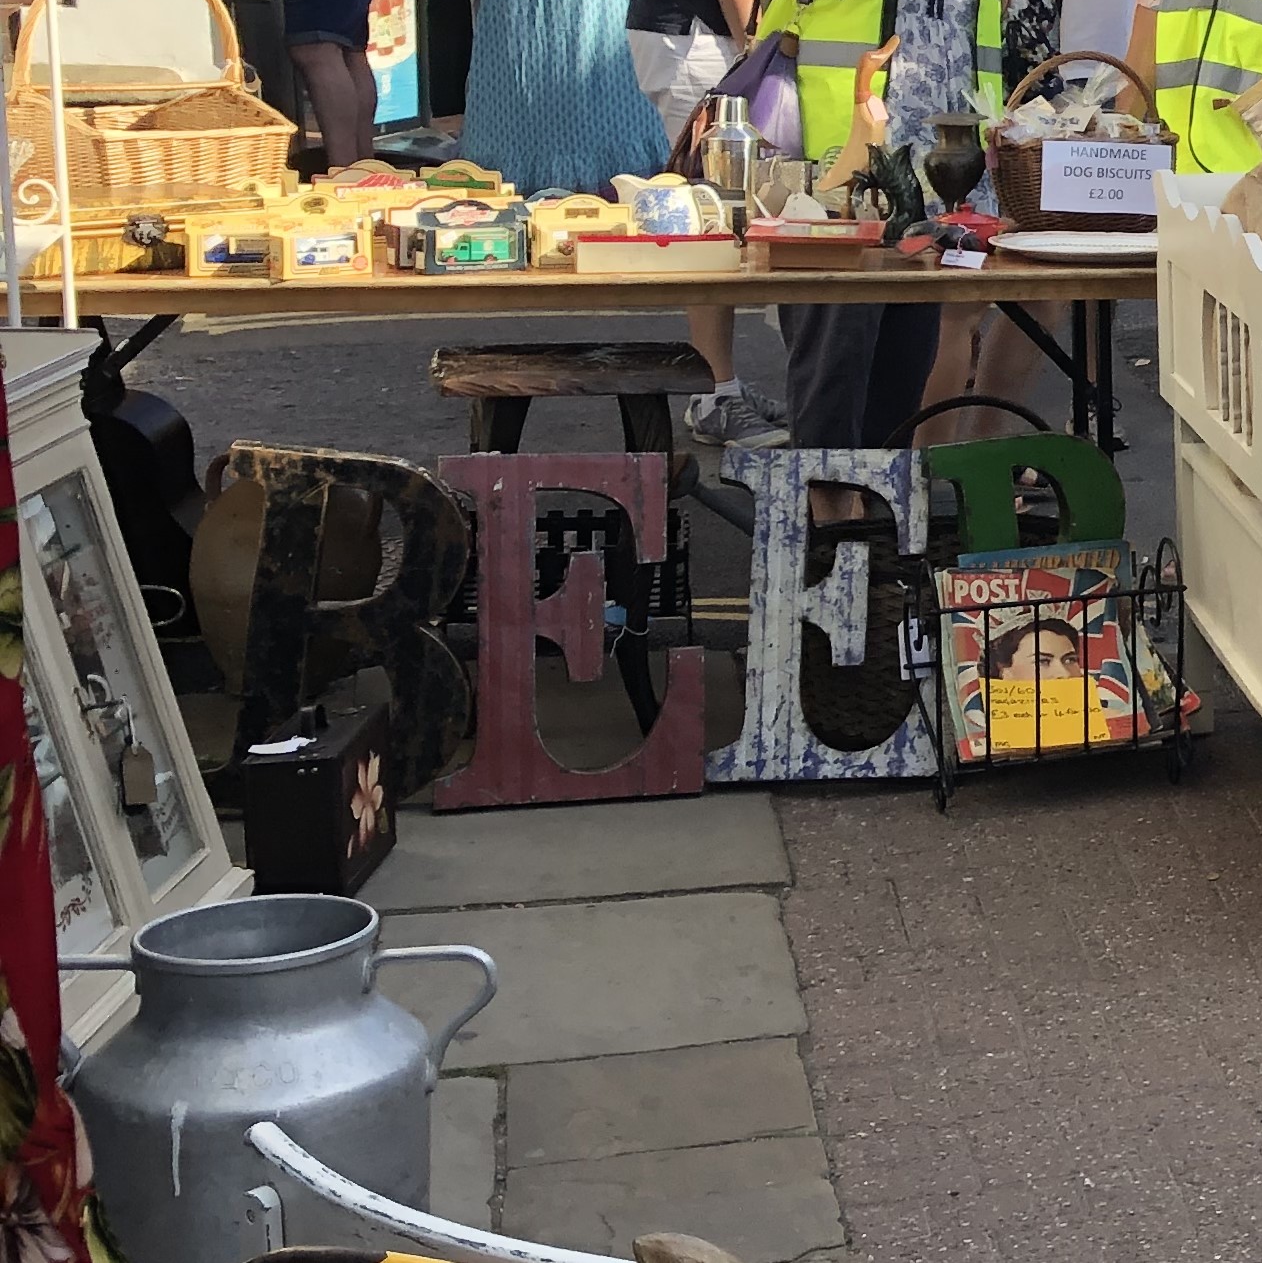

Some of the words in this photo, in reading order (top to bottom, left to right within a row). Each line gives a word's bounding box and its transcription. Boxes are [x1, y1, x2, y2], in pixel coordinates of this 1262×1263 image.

[1070, 146, 1147, 160] HANDMADE
[1063, 165, 1093, 178] DOG
[1097, 167, 1152, 180] BISCUITS
[954, 578, 1020, 604] POST
